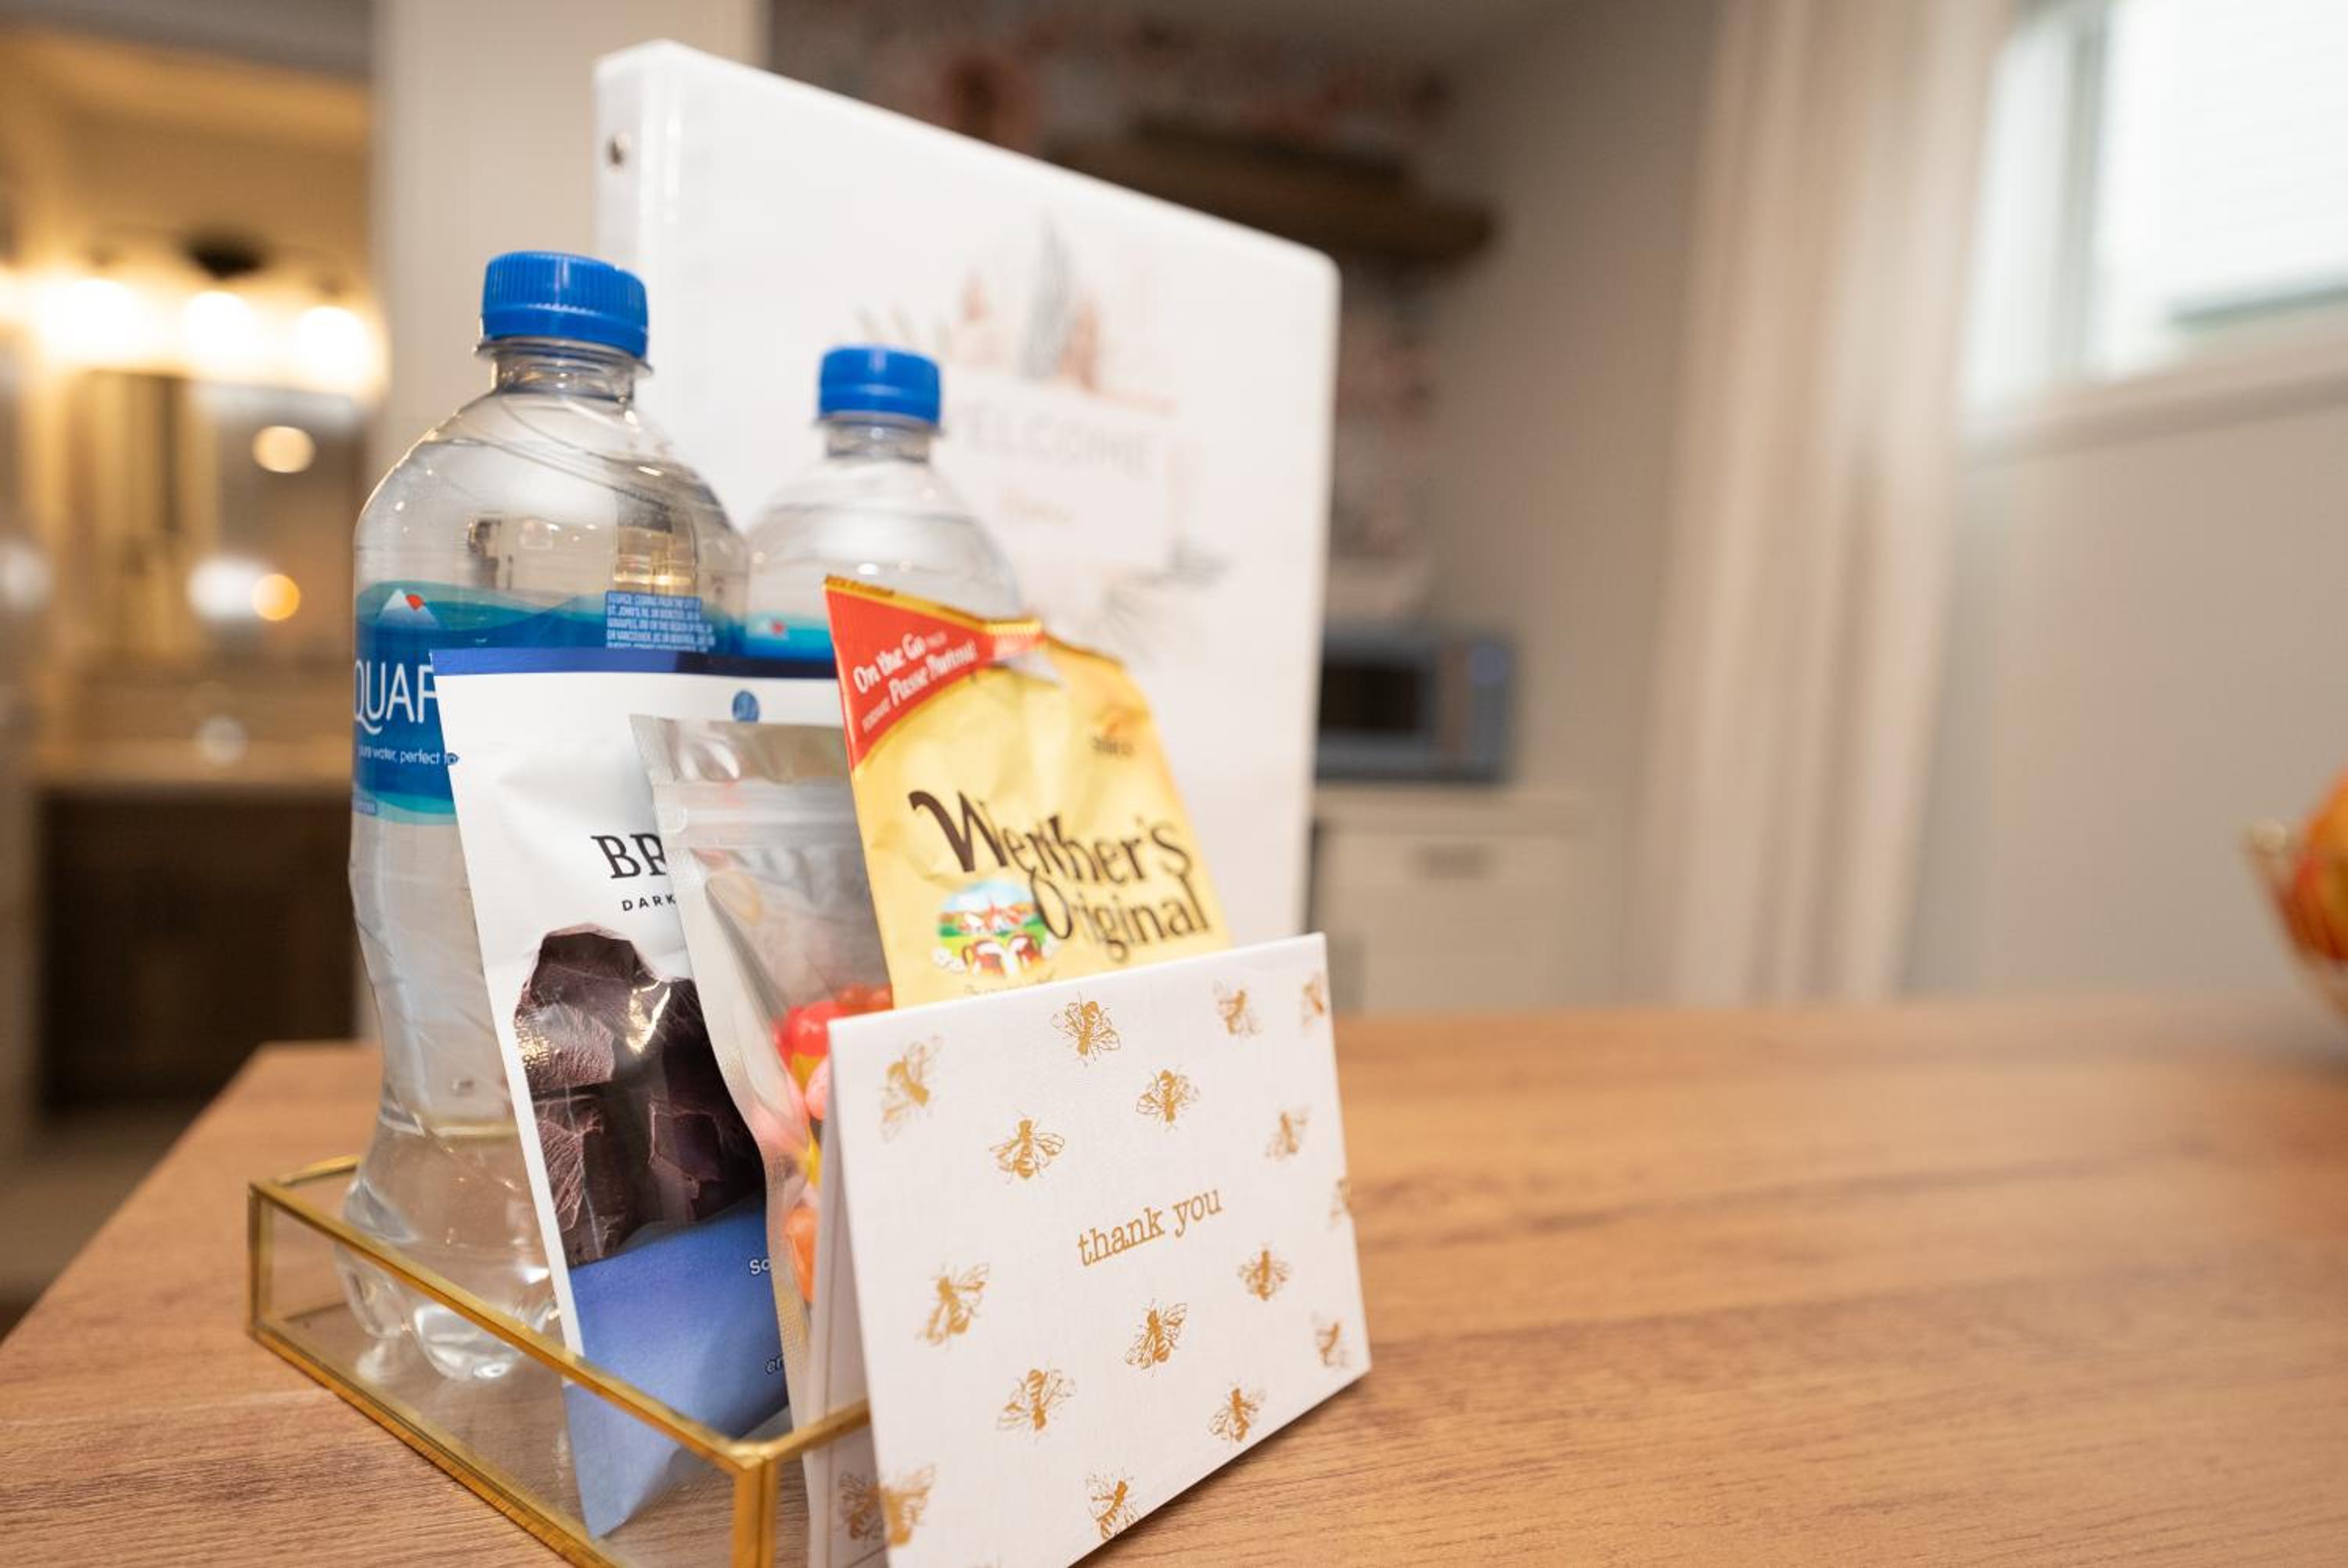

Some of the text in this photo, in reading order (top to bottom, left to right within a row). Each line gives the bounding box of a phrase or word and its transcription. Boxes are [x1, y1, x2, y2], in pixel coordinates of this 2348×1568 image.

[853, 666, 880, 694] On
[876, 647, 906, 676] the
[902, 633, 926, 660] Go
[400, 749, 440, 764] perfect
[622, 894, 676, 912] DARK
[1030, 867, 1209, 964] Original
[1077, 1189, 1223, 1266] thank you
